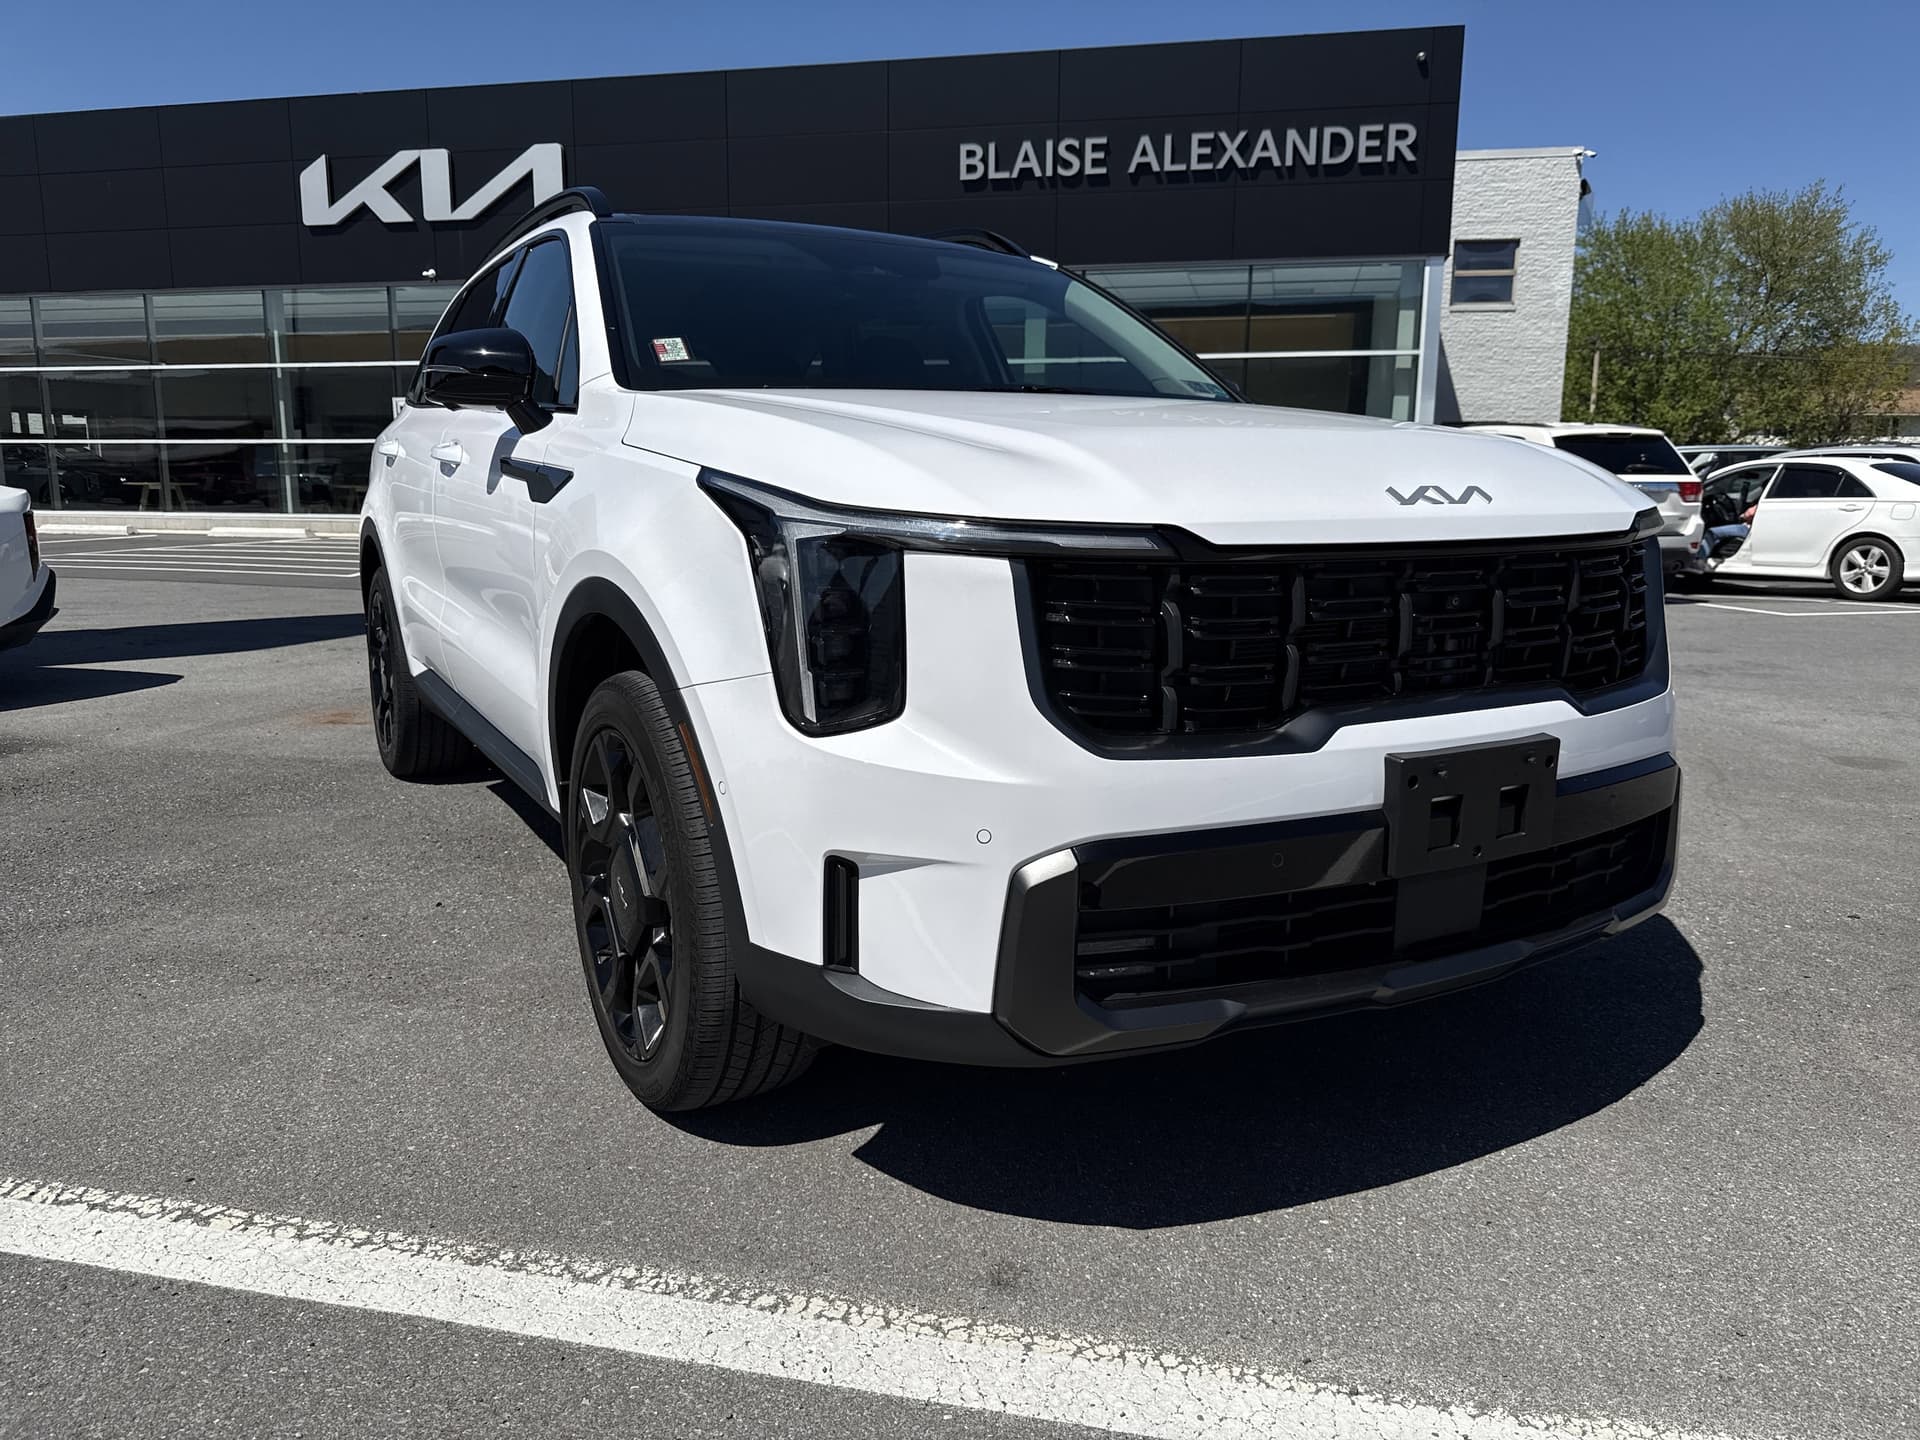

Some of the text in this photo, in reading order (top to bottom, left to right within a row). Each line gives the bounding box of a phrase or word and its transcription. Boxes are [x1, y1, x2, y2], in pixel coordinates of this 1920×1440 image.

[959, 123, 1417, 181] BLAISE ALEXANDER
[300, 143, 563, 226] KIA
[1384, 485, 1493, 506] KIA
